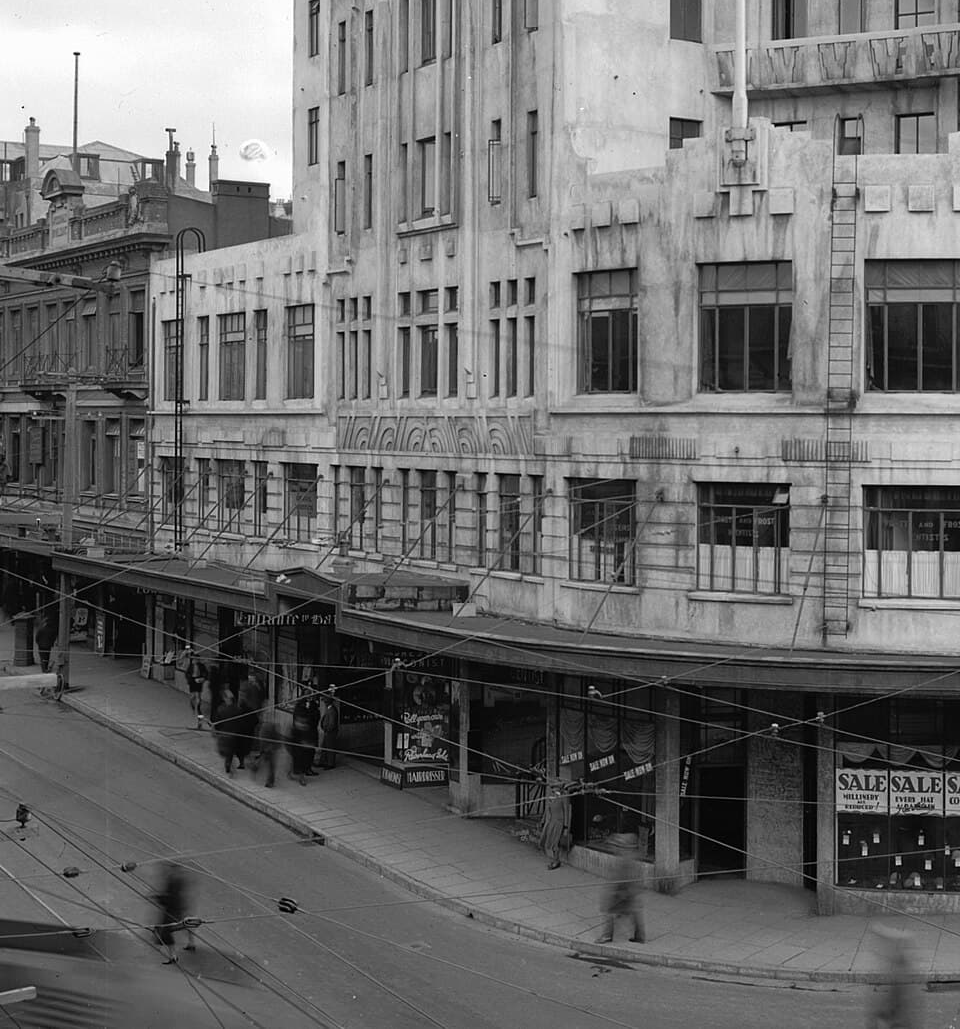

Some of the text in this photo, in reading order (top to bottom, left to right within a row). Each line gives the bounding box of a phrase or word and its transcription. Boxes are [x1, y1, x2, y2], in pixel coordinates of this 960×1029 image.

[838, 773, 887, 793] SALE
[890, 775, 942, 794] SALE
[843, 793, 880, 801] MILLINERY
[895, 795, 935, 804] EVERY HAT
